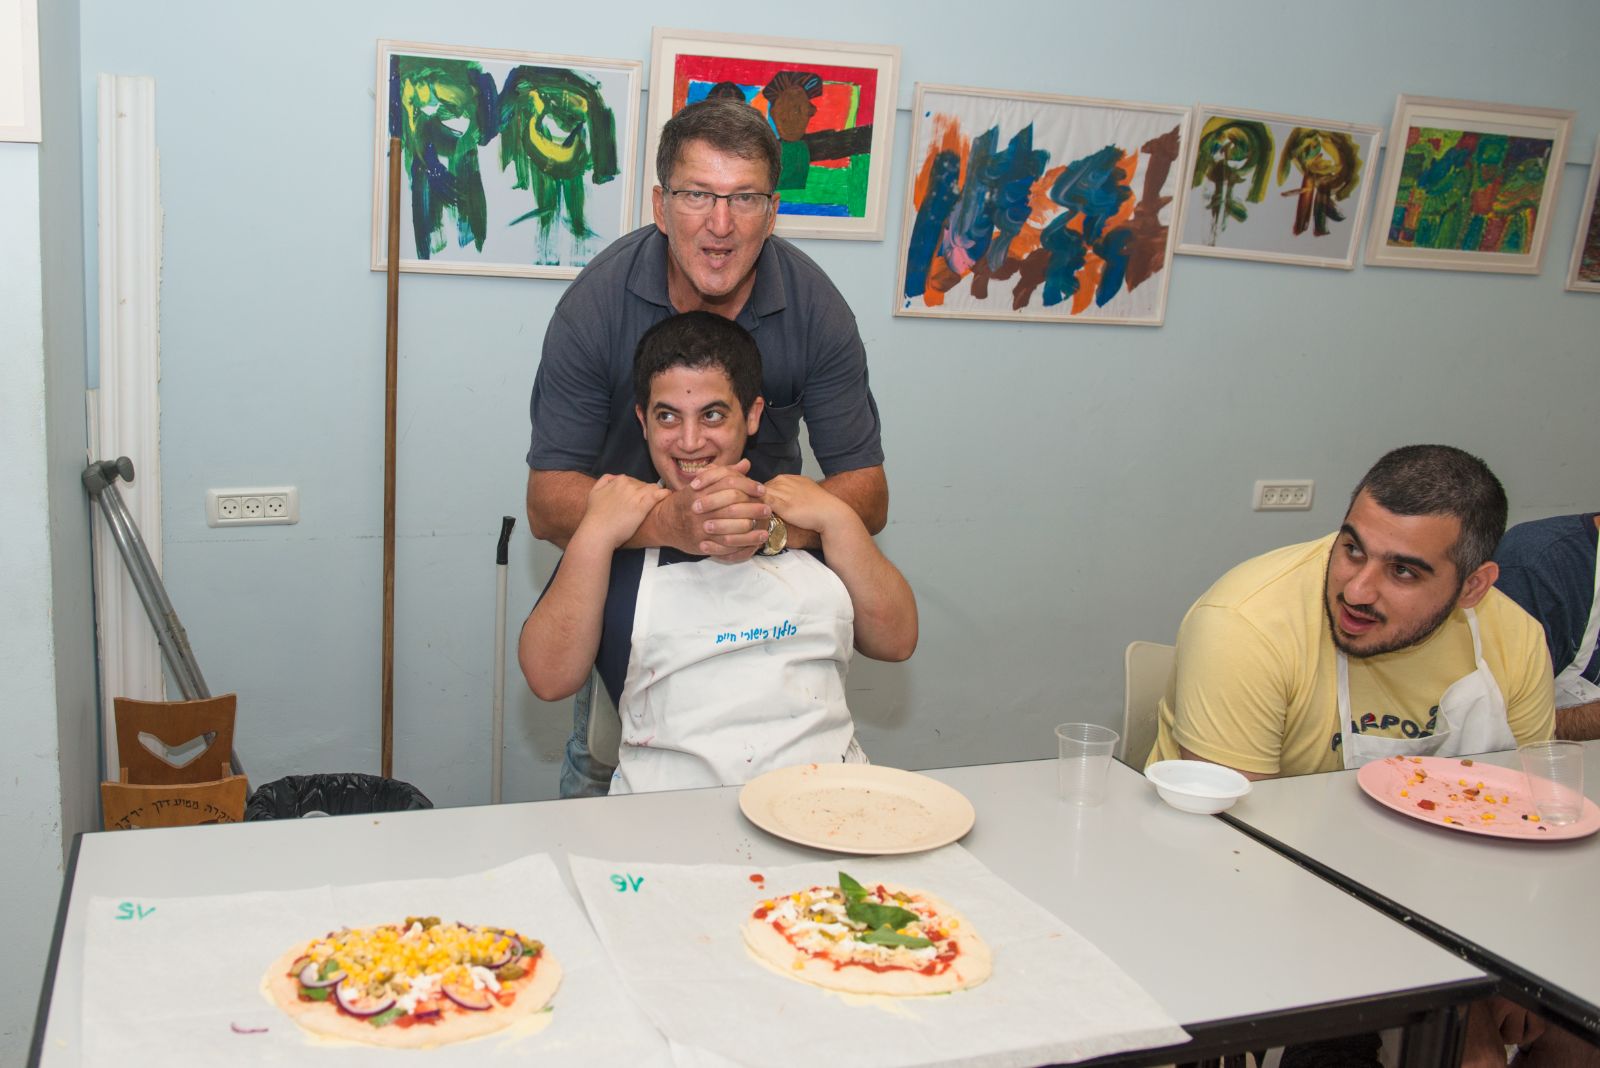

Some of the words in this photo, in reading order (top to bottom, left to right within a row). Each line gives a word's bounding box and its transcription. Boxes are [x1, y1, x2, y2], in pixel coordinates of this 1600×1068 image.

[715, 632, 737, 644] חיים
[740, 627, 769, 641] כישורי
[773, 619, 798, 640] כולנו
[609, 872, 645, 893] 16
[113, 901, 157, 921] 15
